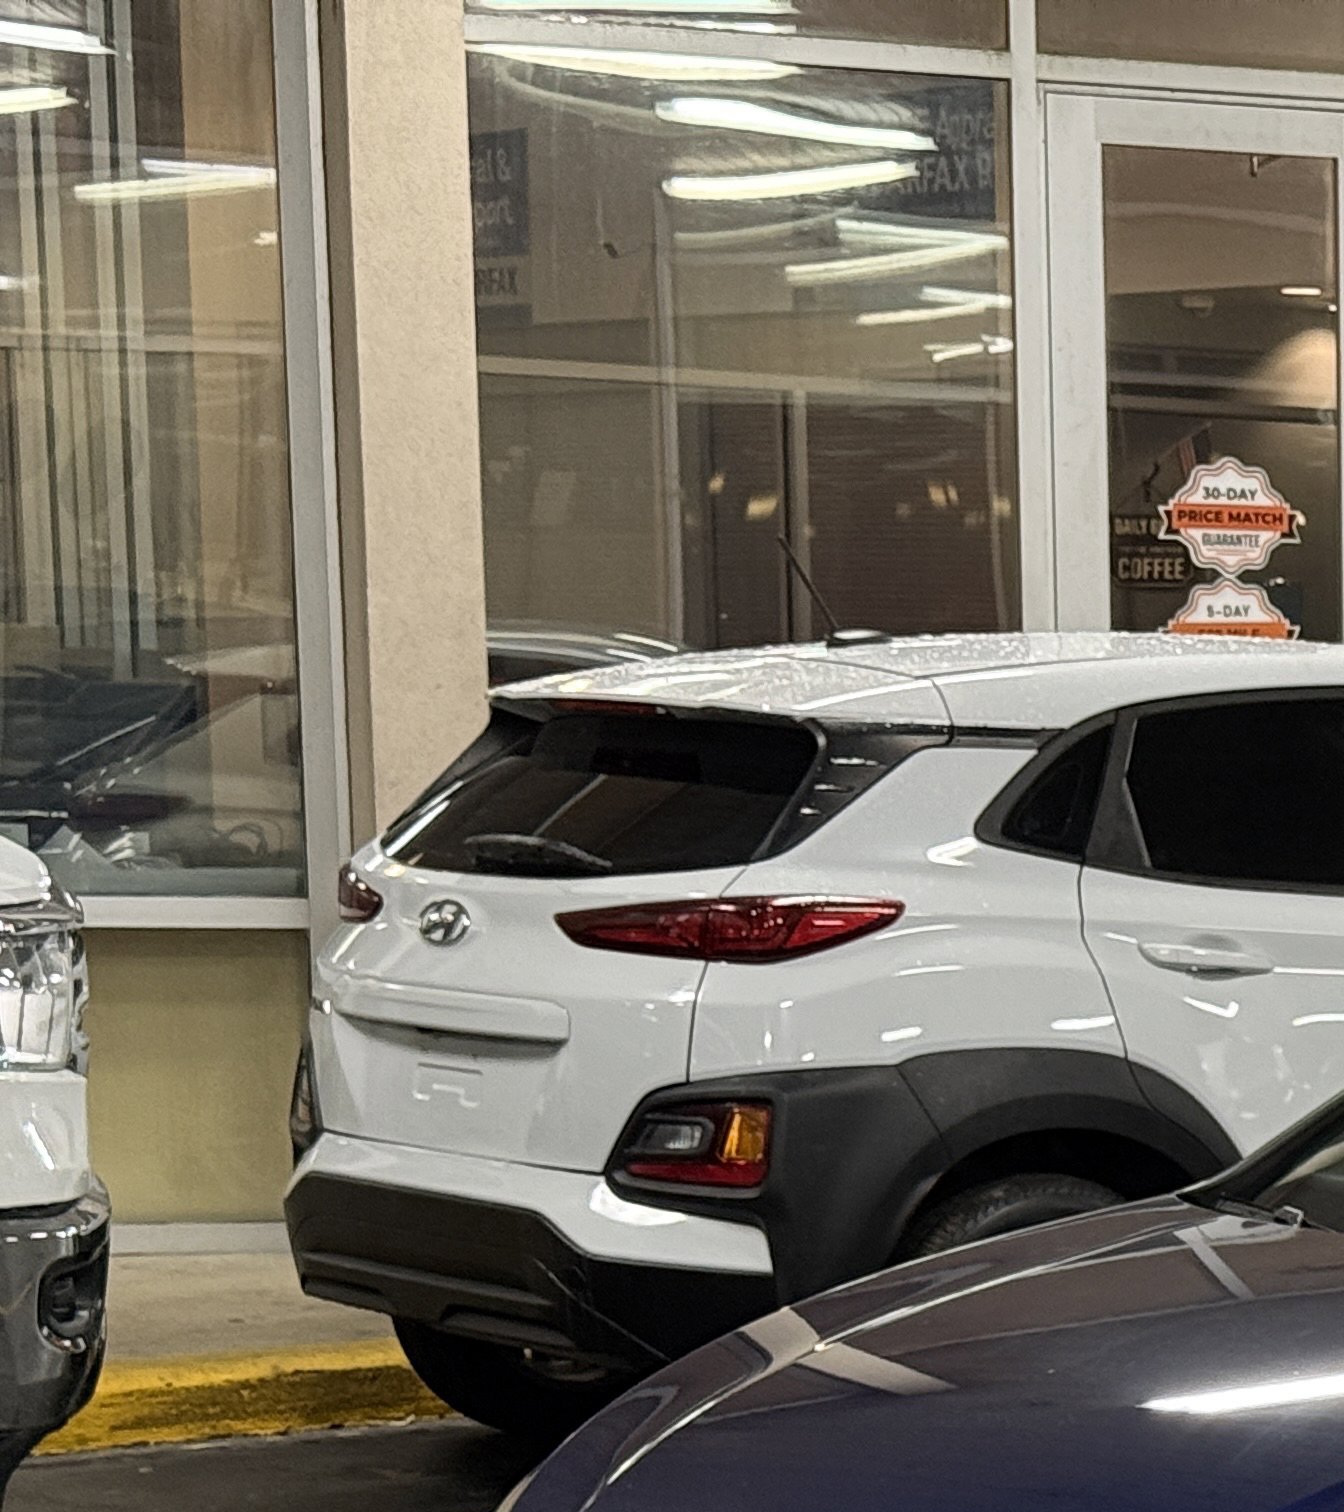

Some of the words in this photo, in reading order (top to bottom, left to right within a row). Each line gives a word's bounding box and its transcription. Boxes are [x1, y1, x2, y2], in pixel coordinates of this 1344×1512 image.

[1202, 487, 1258, 501] 30-DAY
[1177, 510, 1222, 524] PRICE
[1228, 512, 1284, 526] MATCH
[1201, 532, 1261, 548] GUARANTEE
[1118, 557, 1186, 580] COFFEE
